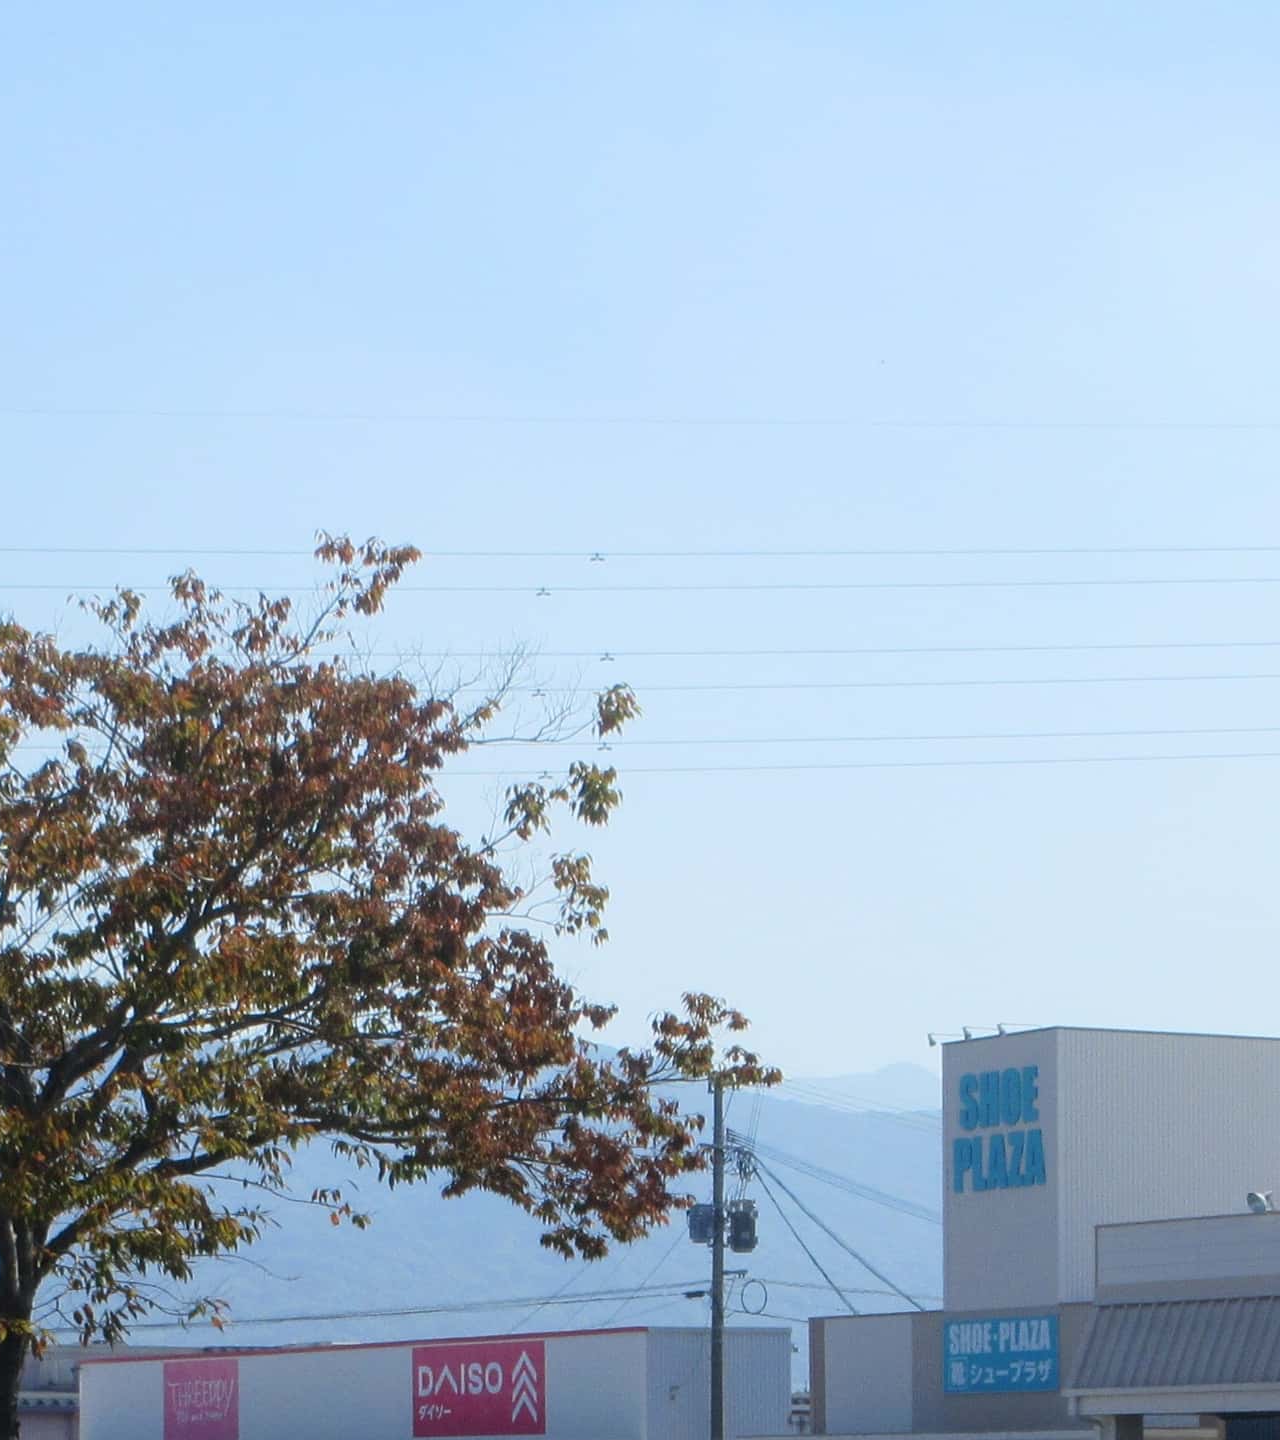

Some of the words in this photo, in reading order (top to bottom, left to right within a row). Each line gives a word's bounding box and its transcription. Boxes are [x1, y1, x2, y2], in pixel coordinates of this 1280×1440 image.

[959, 1064, 1040, 1131] SHOE
[953, 1128, 1047, 1194] PLAZA
[418, 1362, 503, 1397] DAISO
